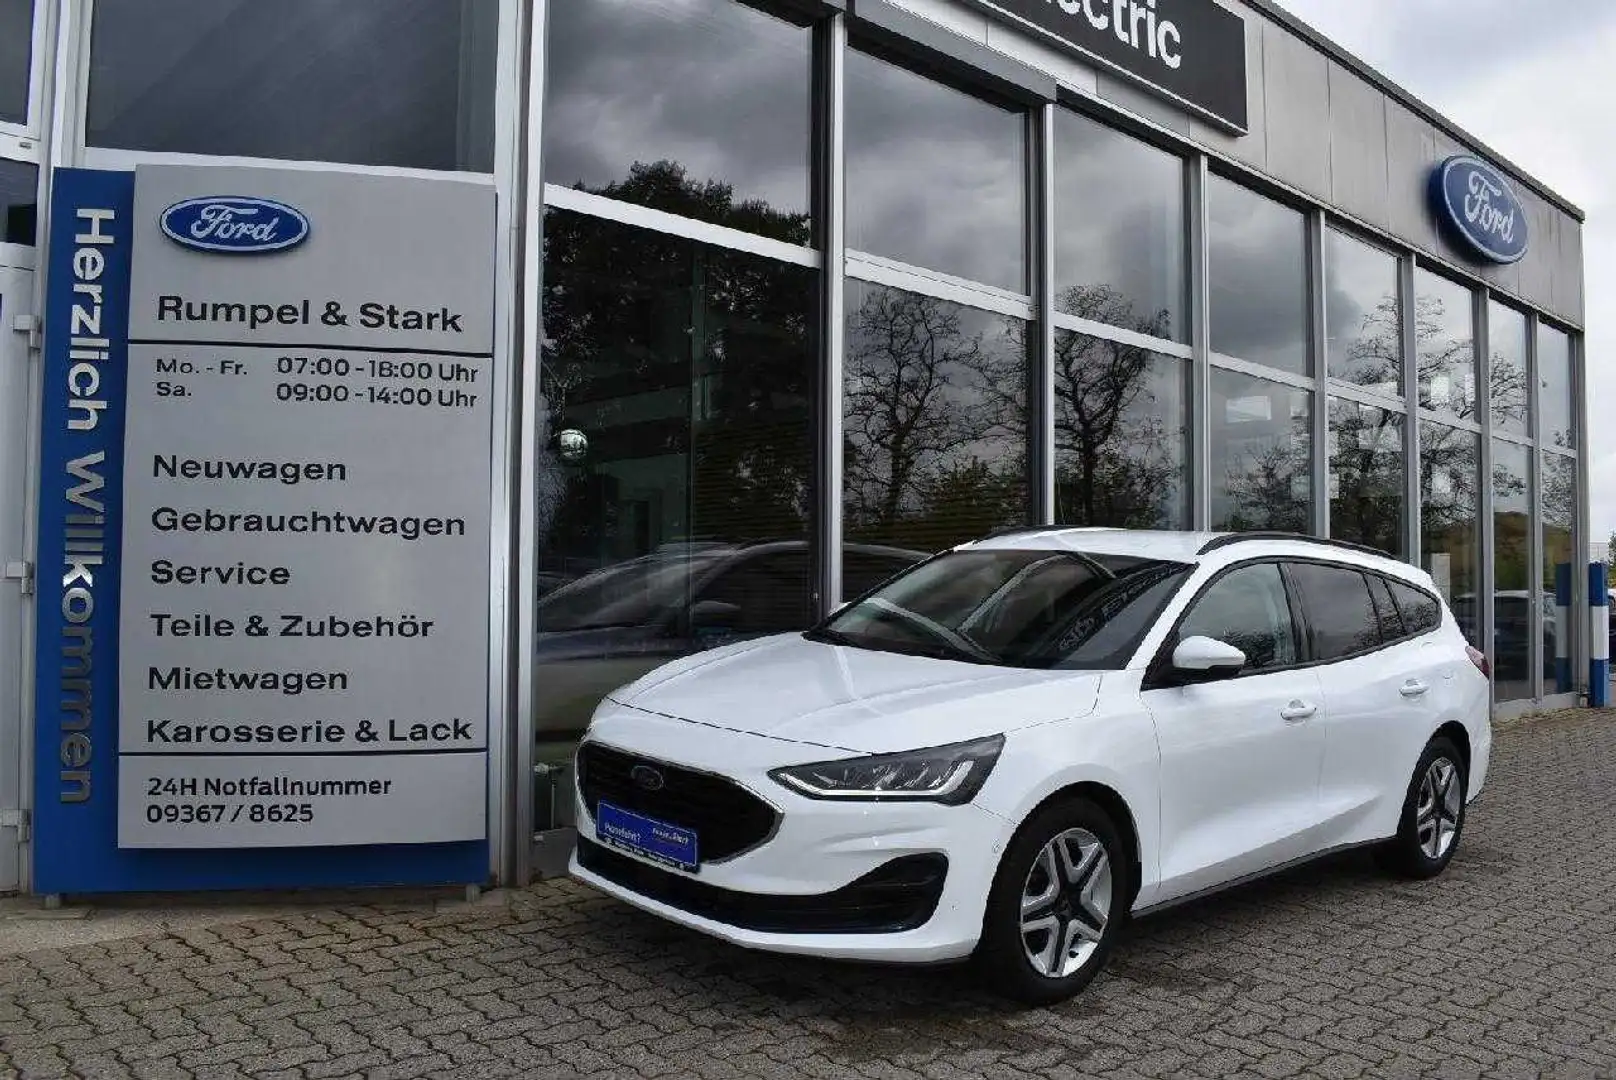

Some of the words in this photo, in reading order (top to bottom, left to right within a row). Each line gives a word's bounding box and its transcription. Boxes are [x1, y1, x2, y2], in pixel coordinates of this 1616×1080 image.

[1464, 170, 1514, 244] Ford
[189, 203, 280, 244] Ford
[67, 208, 115, 431] Herzlich
[157, 296, 310, 330] Rumpel
[320, 301, 350, 327] &
[359, 302, 464, 333] Stark
[156, 358, 200, 375] Mo.
[219, 360, 248, 376] Fr.
[277, 356, 350, 378] 07:00
[438, 363, 479, 384] Uhr
[156, 381, 193, 398] Sa.
[276, 382, 350, 403] 09:00
[437, 389, 478, 409] Uhr
[153, 454, 347, 486] Neuwagen
[151, 506, 466, 541] Gebrauchtwagen
[151, 559, 291, 586] Service
[60, 451, 106, 804] Willkommen
[150, 613, 235, 638] Teile
[244, 614, 269, 638] &
[279, 614, 434, 639] Zubehör
[148, 666, 348, 696] Mietwagen
[147, 719, 346, 744] Karosserie
[354, 719, 380, 743] &
[388, 717, 473, 743] Lack
[147, 777, 198, 797] 24H
[203, 776, 393, 797] Notfallnummer
[146, 803, 226, 824] 09367
[230, 804, 245, 824] /
[248, 803, 314, 824] 8625
